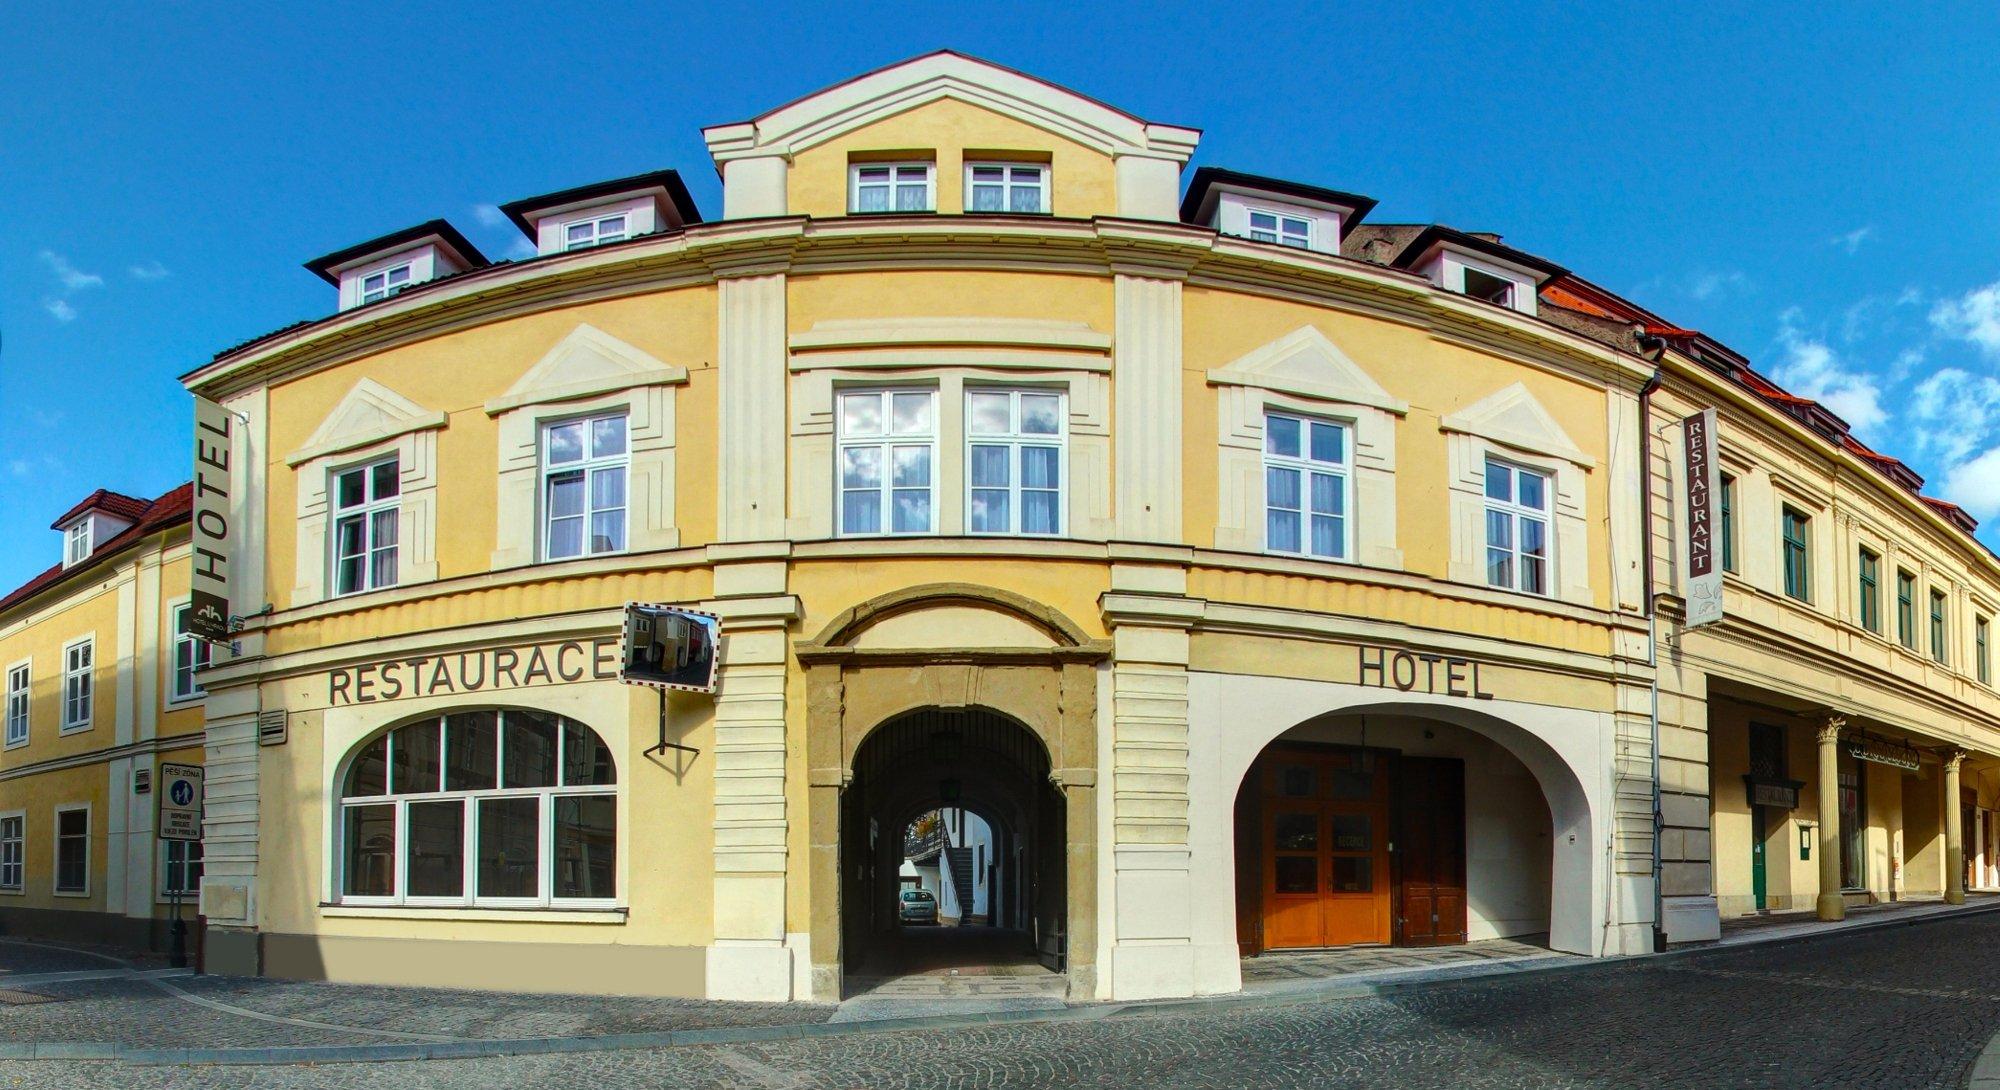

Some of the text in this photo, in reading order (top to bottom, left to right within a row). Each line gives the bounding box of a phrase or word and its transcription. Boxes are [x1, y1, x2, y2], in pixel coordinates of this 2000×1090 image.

[197, 417, 229, 583] HOTEL
[1690, 422, 1709, 569] RESTAURANT
[330, 638, 618, 705] RESTAURACE
[1360, 645, 1494, 700] HOTEL
